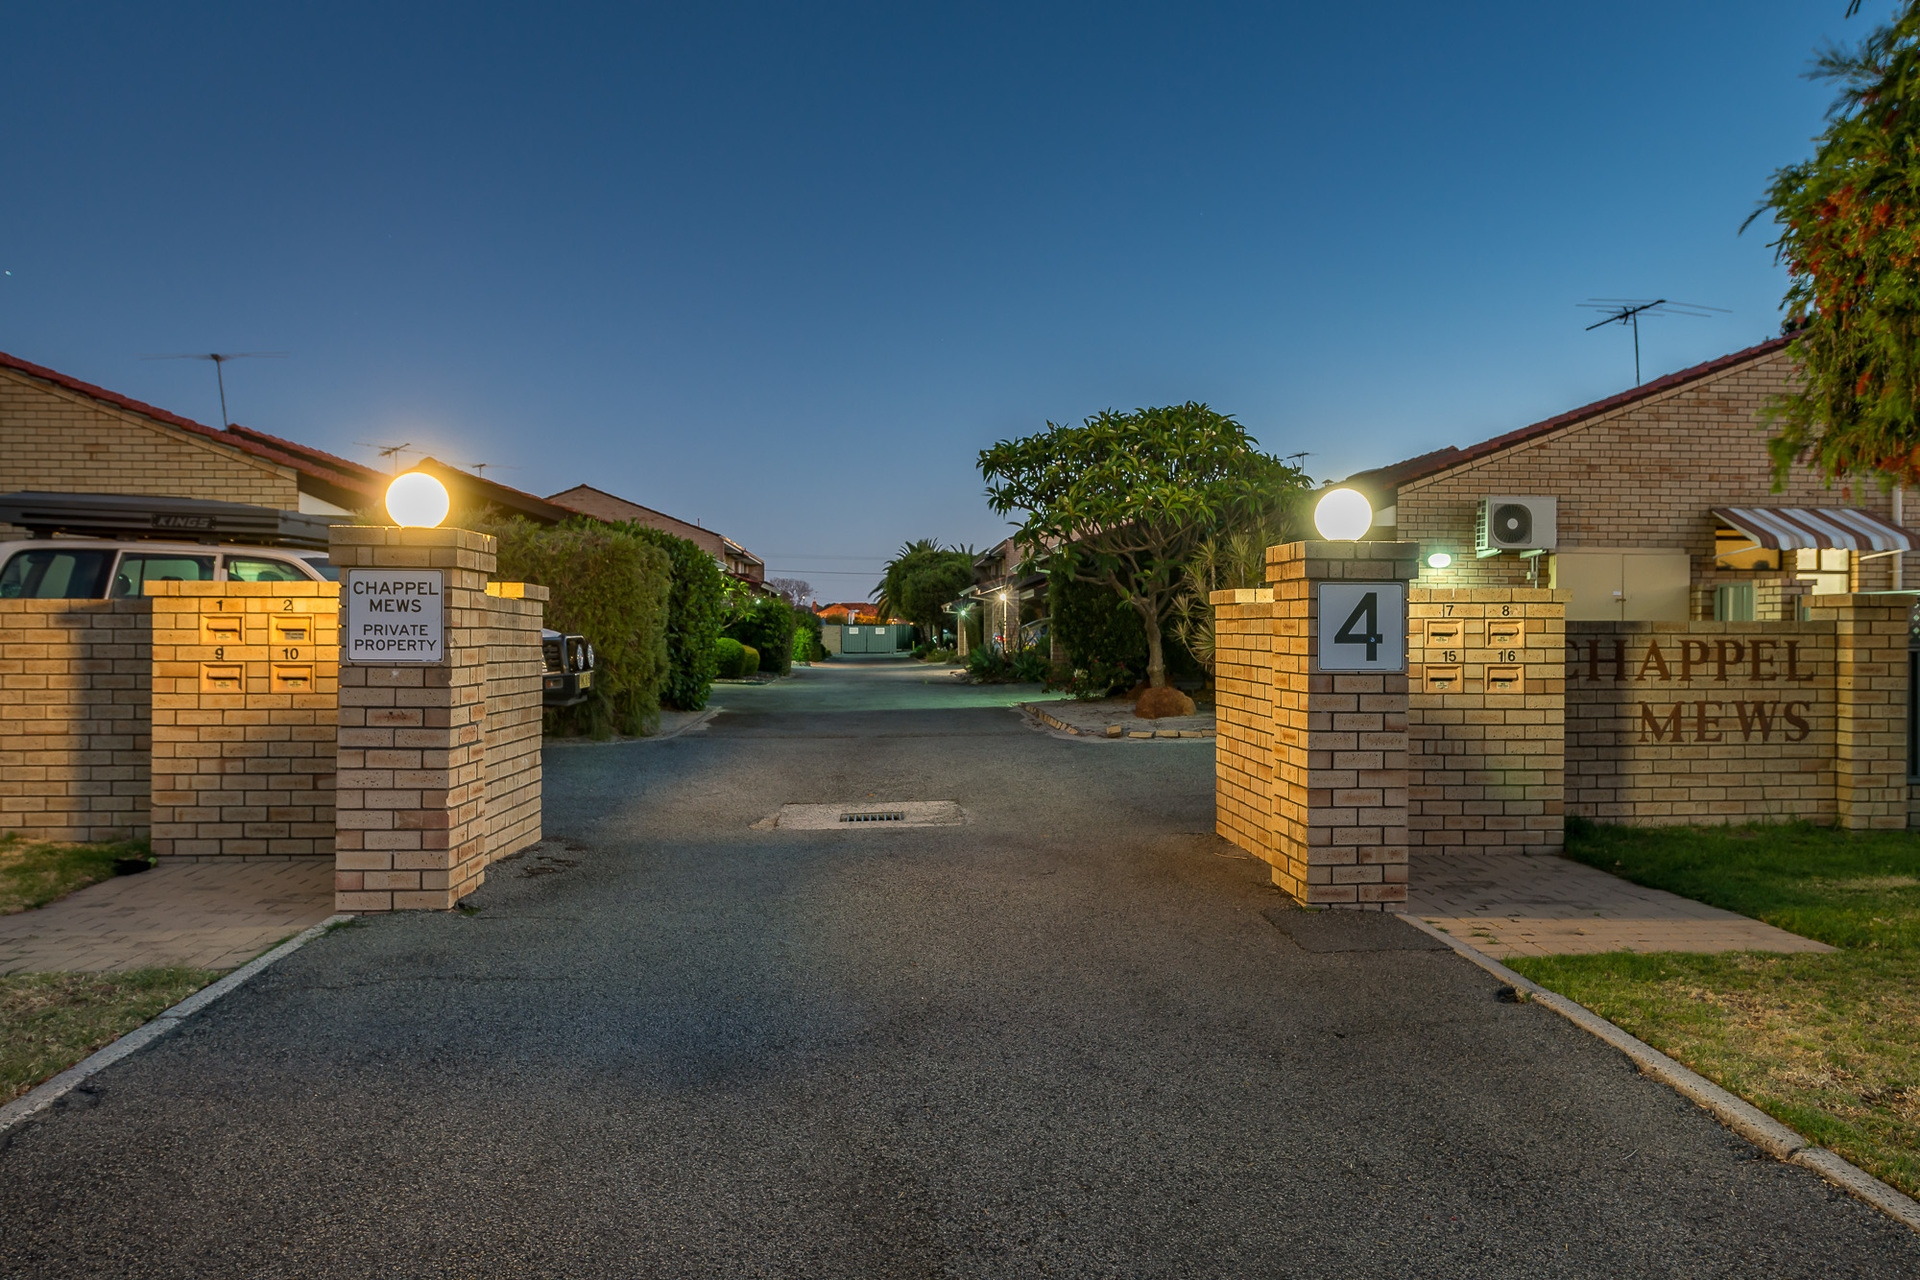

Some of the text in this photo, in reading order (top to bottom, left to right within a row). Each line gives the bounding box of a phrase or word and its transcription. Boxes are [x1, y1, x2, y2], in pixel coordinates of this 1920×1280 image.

[157, 516, 211, 528] KINGS
[353, 581, 439, 596] CHAPPEL
[216, 600, 223, 611] 1
[283, 600, 293, 612] 2
[369, 599, 422, 613] MEWS
[1445, 605, 1455, 616] 7
[1502, 605, 1510, 616] 8
[363, 624, 428, 636] PRIVATE
[1333, 592, 1384, 662] 4
[354, 639, 437, 651] PROPERTY
[215, 648, 224, 660] 9
[282, 648, 299, 660] 10
[1442, 650, 1457, 662] 15
[1498, 650, 1516, 662] 16
[1638, 700, 1811, 743] MEWS
